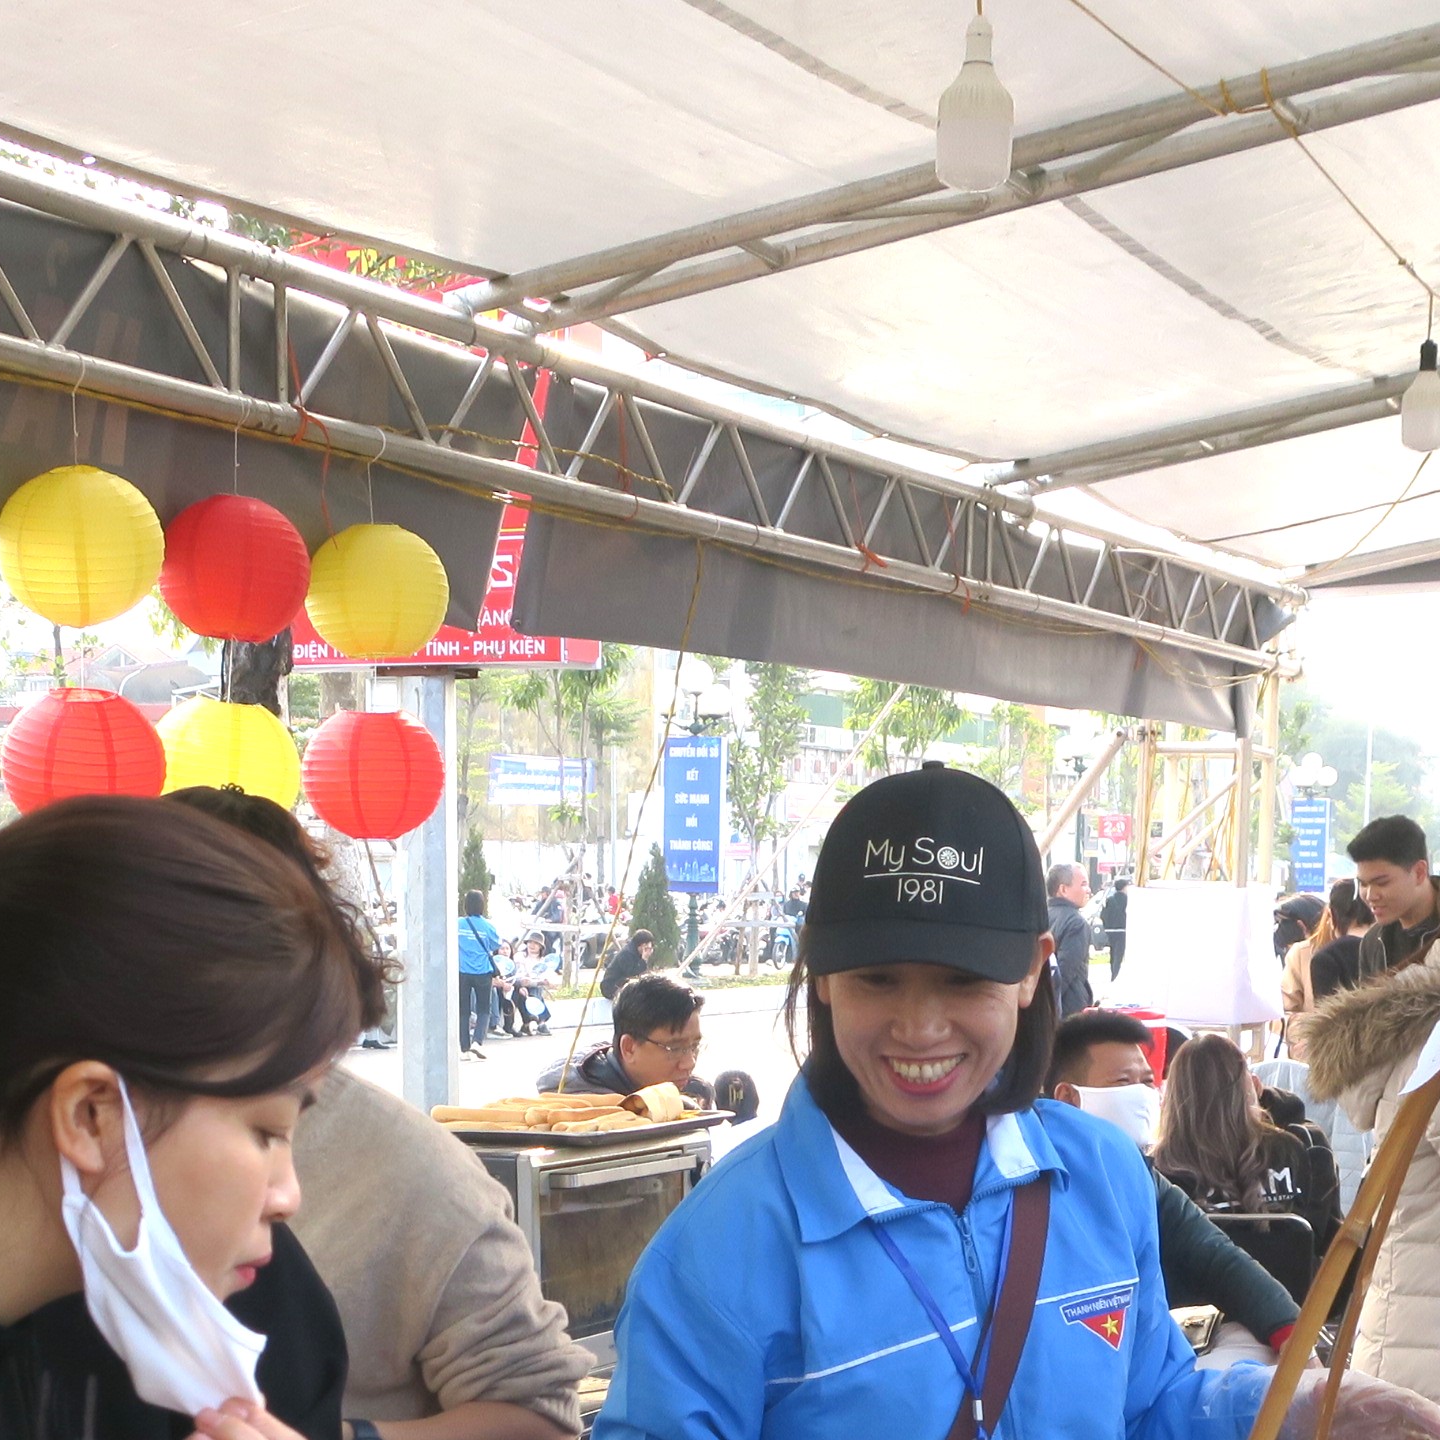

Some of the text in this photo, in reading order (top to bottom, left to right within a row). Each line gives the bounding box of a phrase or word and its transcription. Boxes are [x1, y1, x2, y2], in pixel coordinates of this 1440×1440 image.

[426, 637, 460, 657] TÍNH
[473, 639, 506, 659] PHỤ
[509, 634, 546, 660] KIỆN
[864, 836, 984, 876] My Soul
[897, 878, 944, 905] 1981
[1064, 1303, 1092, 1318] THANH
